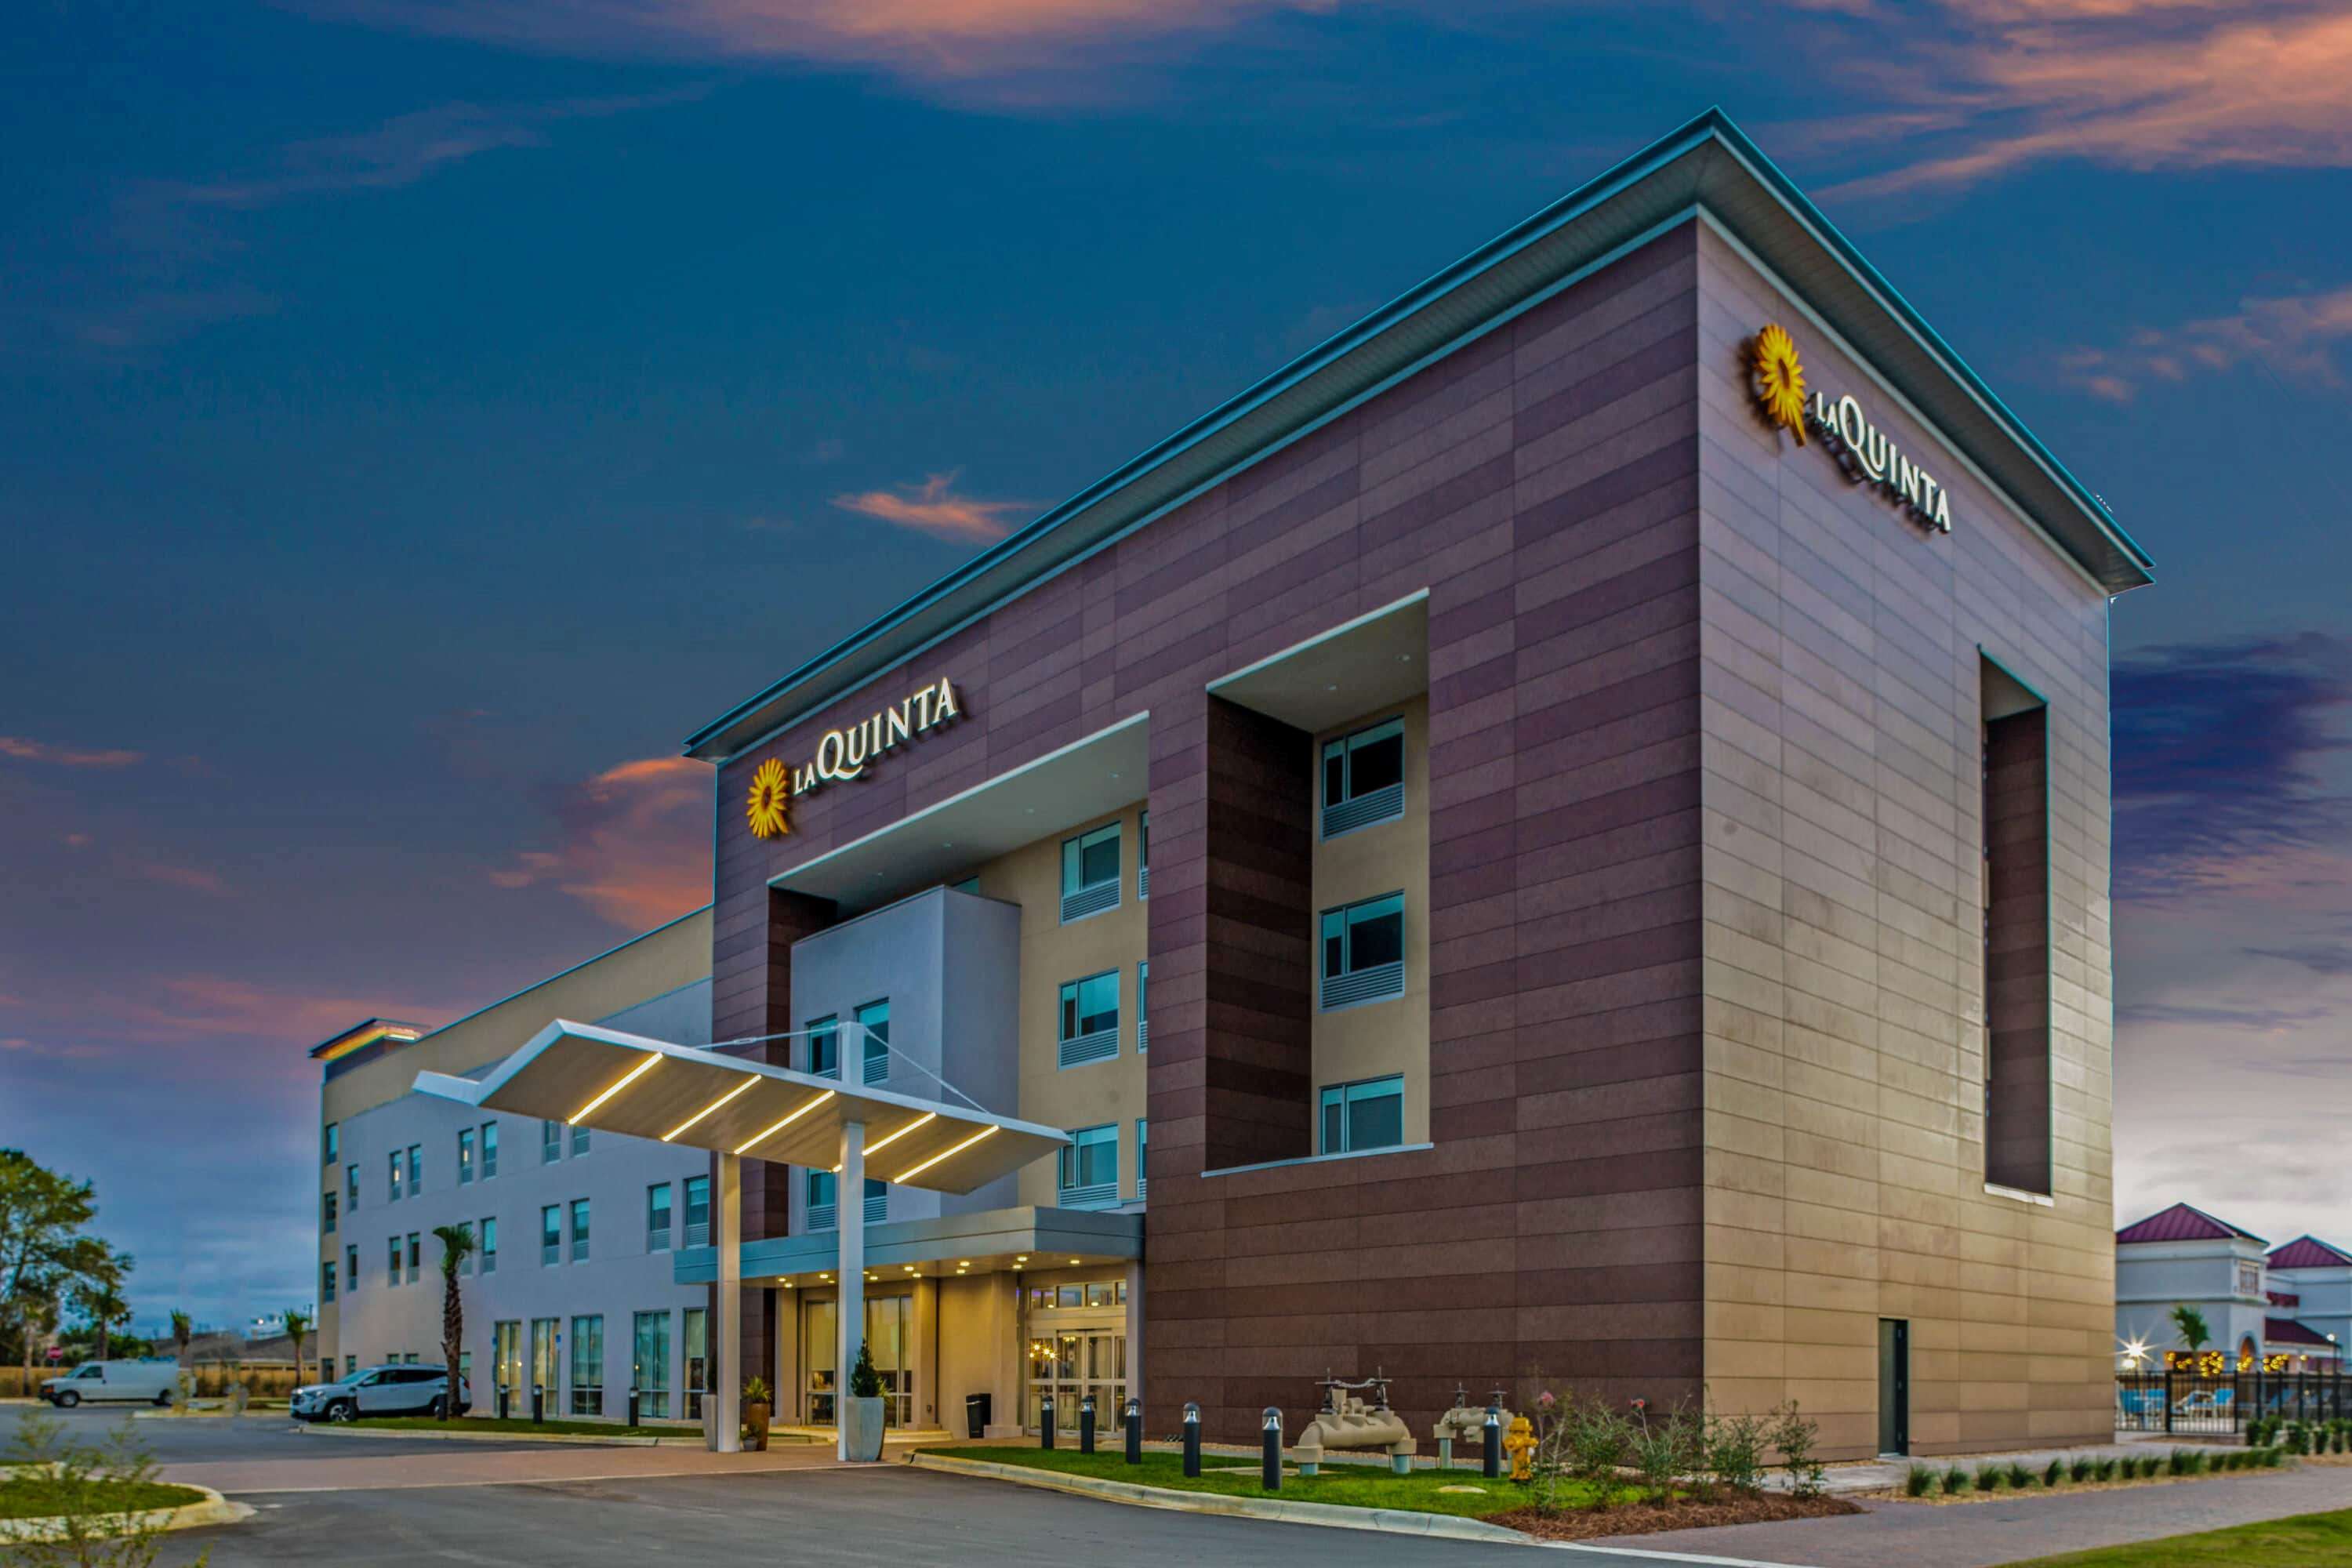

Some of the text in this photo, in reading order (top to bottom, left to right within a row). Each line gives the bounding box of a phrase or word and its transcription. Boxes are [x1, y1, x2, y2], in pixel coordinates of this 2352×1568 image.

[1816, 391, 1951, 532] LA QUINTA
[793, 677, 959, 797] LA QUINTA
